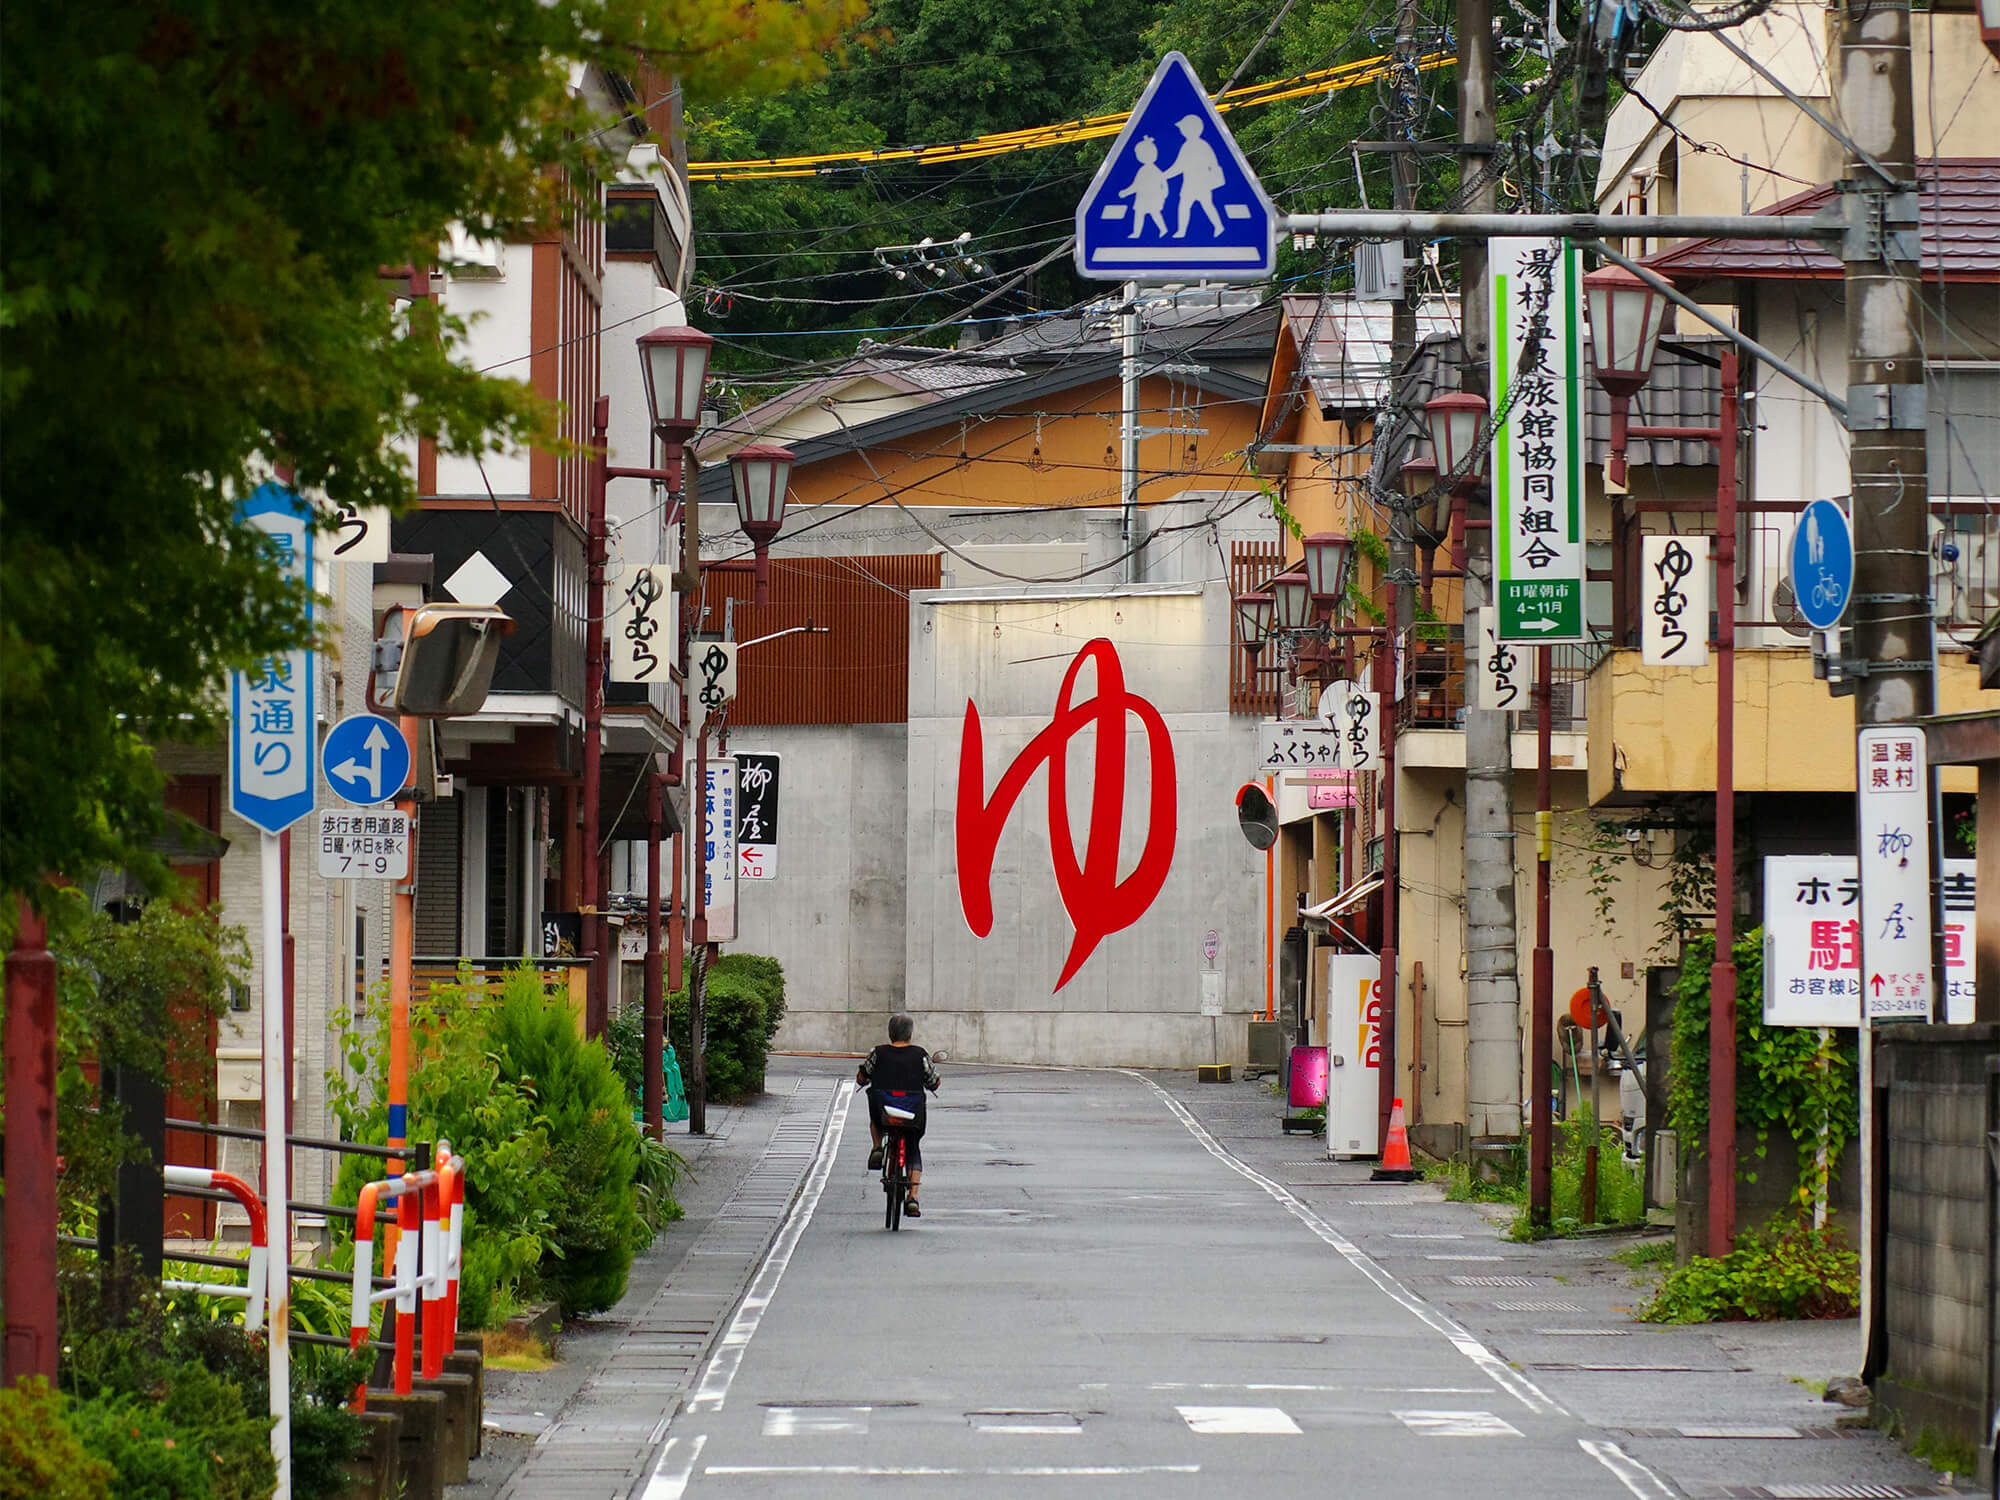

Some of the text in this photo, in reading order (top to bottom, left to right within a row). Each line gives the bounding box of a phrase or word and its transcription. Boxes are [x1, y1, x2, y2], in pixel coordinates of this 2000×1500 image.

[1510, 584, 1569, 598] 日曜朝市
[1654, 540, 1693, 660] ゆむら
[625, 568, 663, 680] ゆむら
[1486, 628, 1517, 708] むら
[1346, 695, 1371, 768] ゆむら
[1872, 743, 1889, 788] 温泉
[1895, 742, 1913, 787] 湯村
[323, 816, 404, 834] 歩行者用道路
[956, 637, 1177, 995] ゆ
[323, 837, 403, 855] 日曜・休日を除く
[740, 866, 763, 878] 入口
